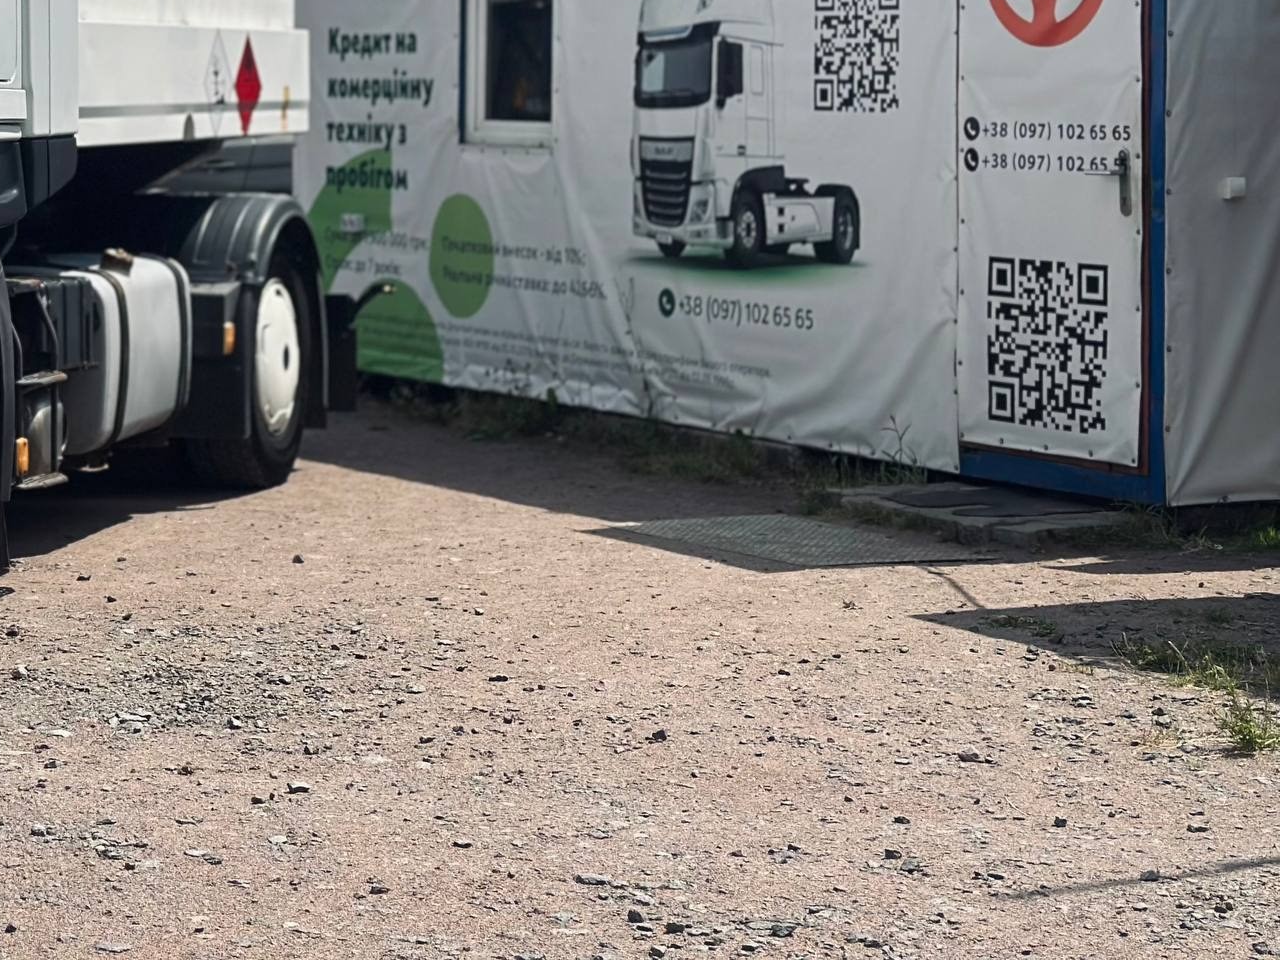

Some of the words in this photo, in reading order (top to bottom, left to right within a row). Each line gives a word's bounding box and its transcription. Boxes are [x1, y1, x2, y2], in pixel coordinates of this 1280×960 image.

[328, 28, 392, 61] Кредит
[396, 32, 417, 54] на
[327, 70, 434, 106] комерційну
[326, 114, 395, 151] техніку
[982, 122, 1008, 138] +38
[1014, 121, 1051, 140] (097)
[1057, 124, 1085, 140] 102
[1089, 125, 1107, 140] 65
[1112, 125, 1131, 140] 65
[326, 161, 408, 194] пробігом
[982, 153, 1008, 169] +38
[1012, 152, 1050, 172] (097)
[1057, 155, 1085, 172] 102
[1089, 157, 1108, 171] 65
[679, 295, 703, 317] +38
[706, 296, 742, 326] (097)
[745, 303, 769, 325] 102
[773, 306, 792, 328] 65
[795, 309, 814, 330] 65
